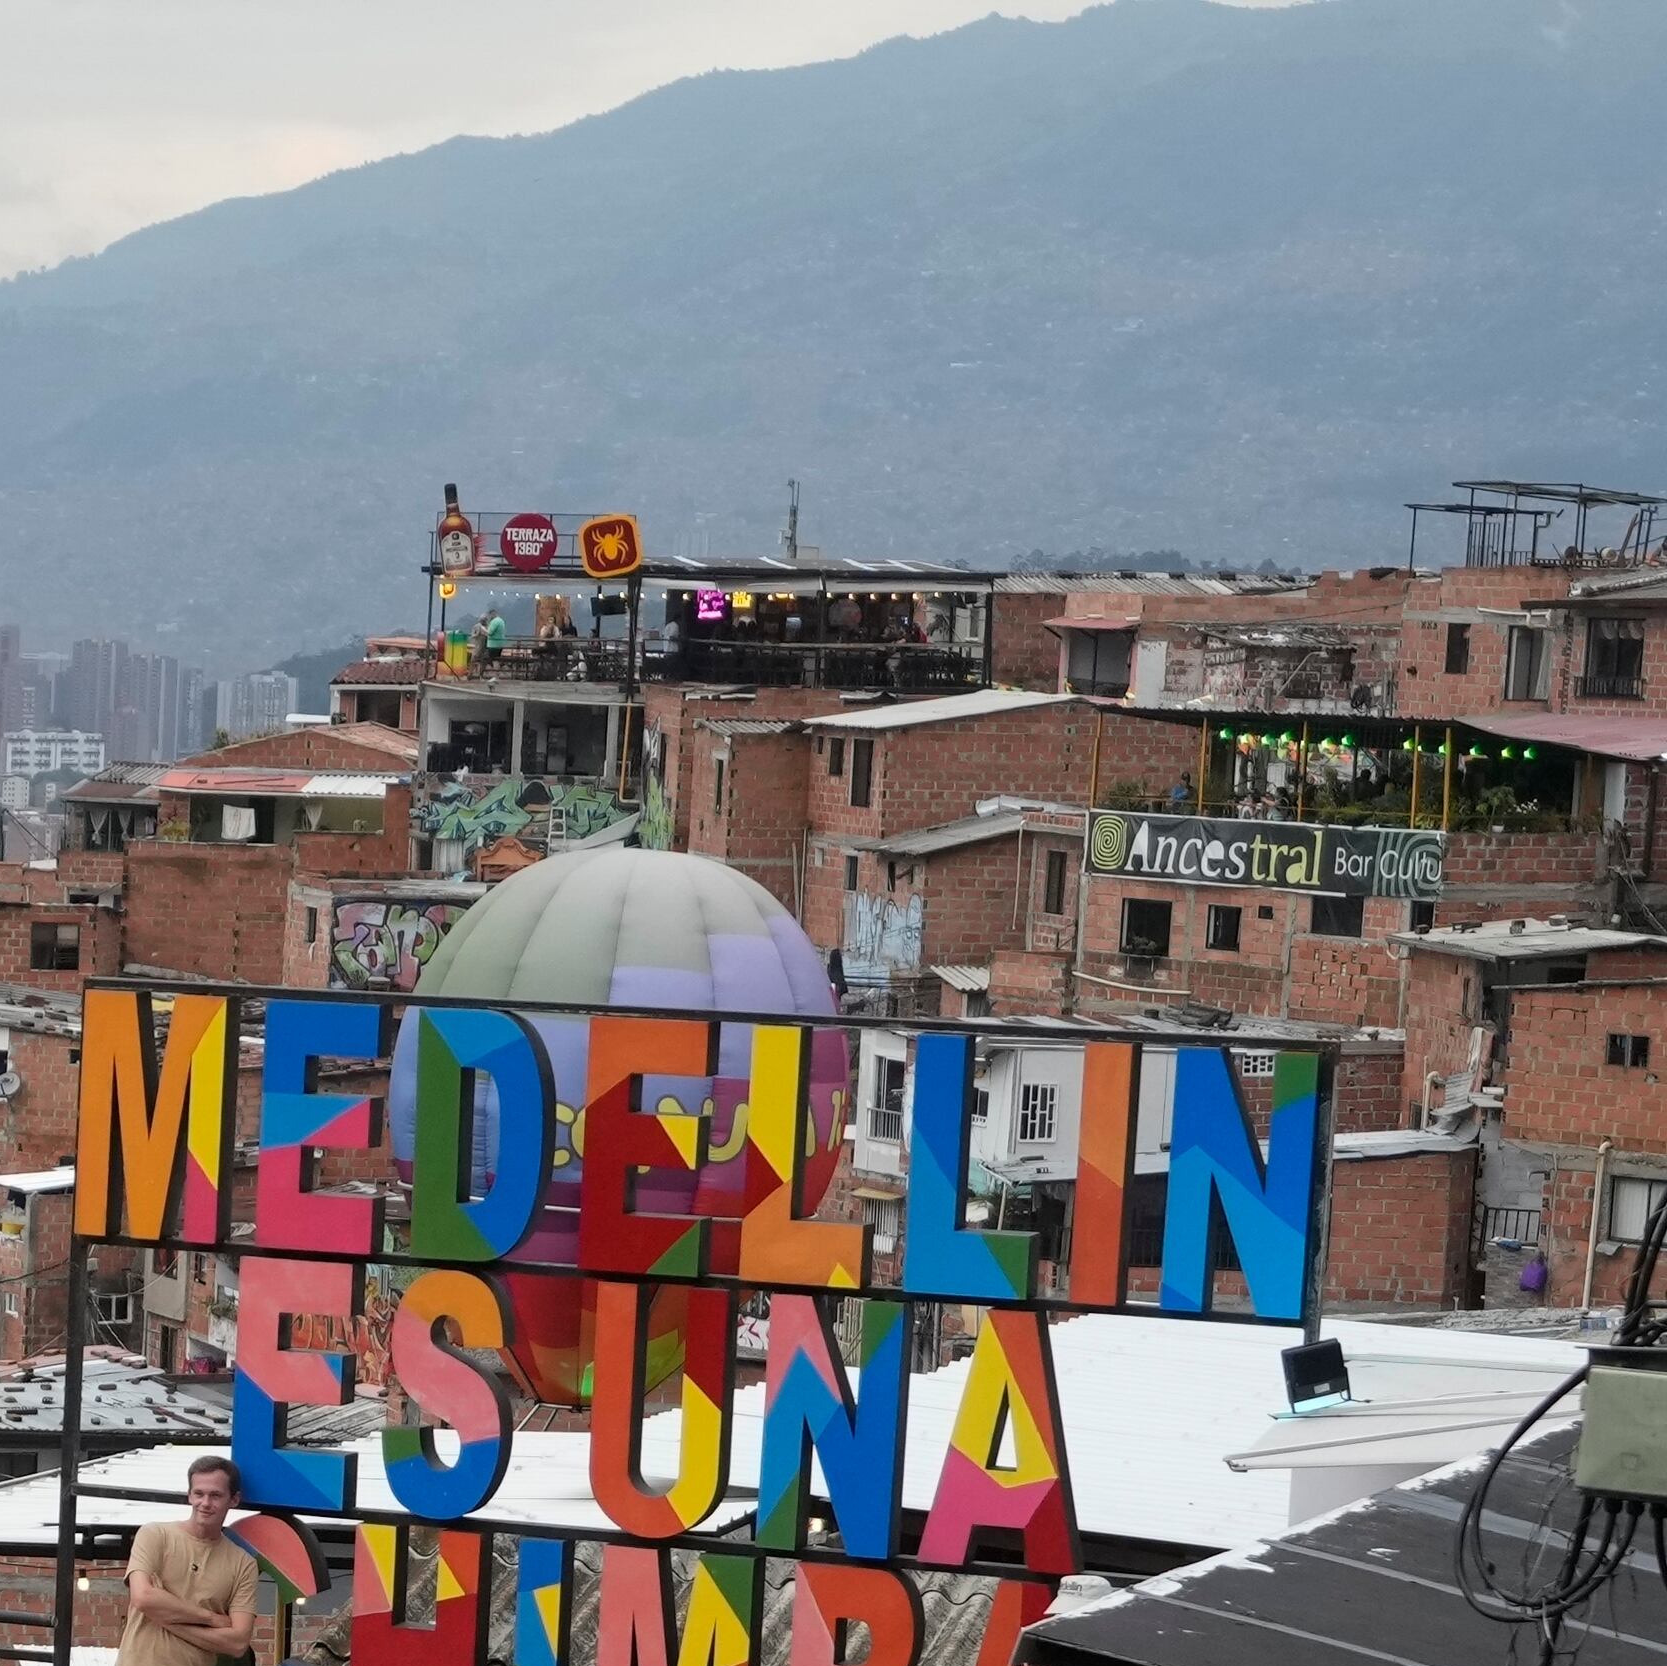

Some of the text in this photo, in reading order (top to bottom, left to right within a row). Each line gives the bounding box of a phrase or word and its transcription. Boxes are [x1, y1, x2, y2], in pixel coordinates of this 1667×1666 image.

[505, 527, 554, 542] TERRAZA
[1124, 821, 1321, 885] Ancestral
[1335, 851, 1374, 877] Bar
[74, 990, 1321, 1321] MEDELLIN
[231, 1255, 513, 1520] ES
